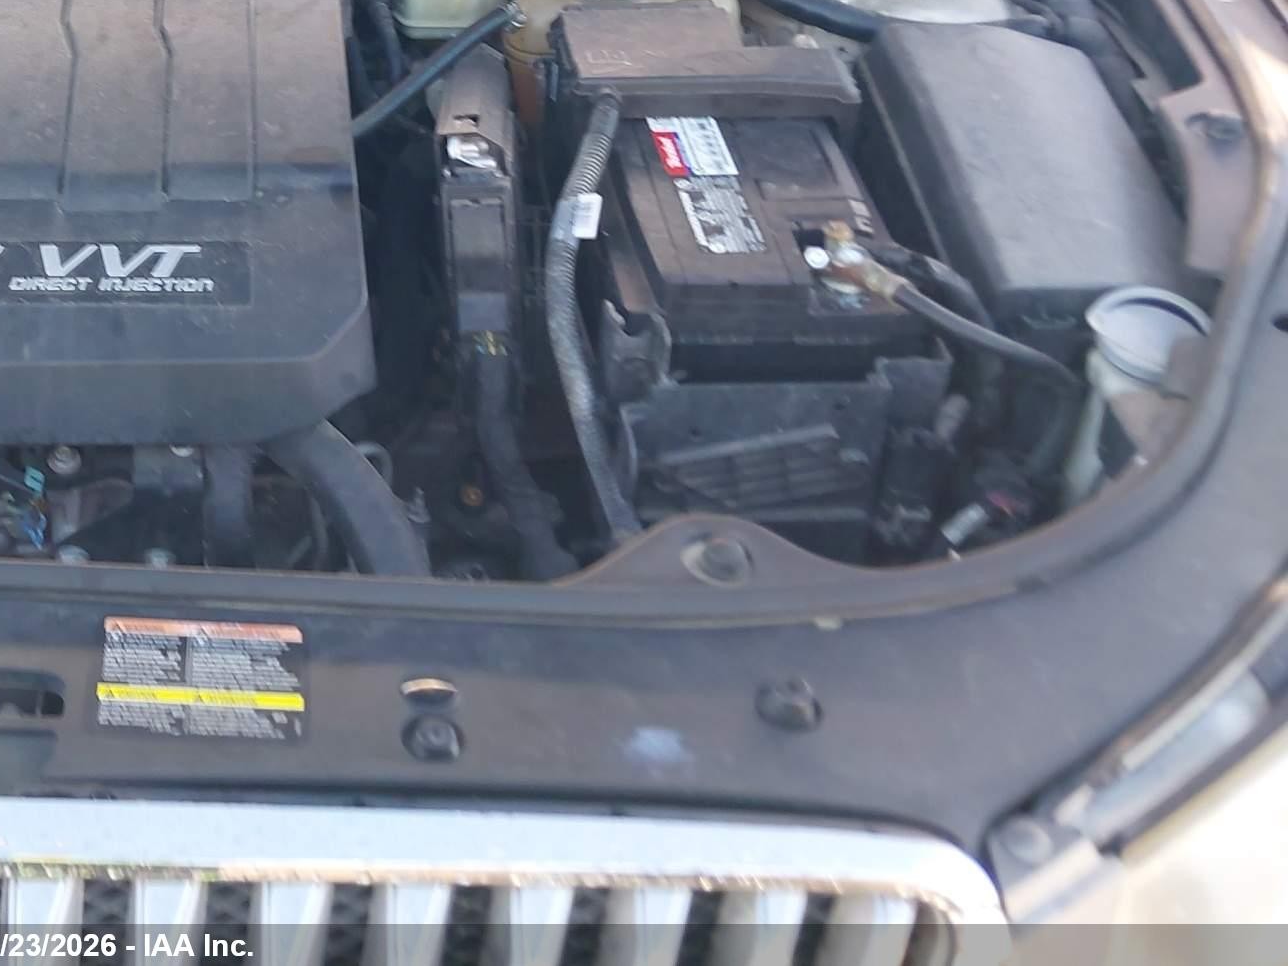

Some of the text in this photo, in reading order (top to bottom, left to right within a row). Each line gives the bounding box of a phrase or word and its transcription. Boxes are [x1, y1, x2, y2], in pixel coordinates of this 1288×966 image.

[38, 243, 202, 278] VVT
[8, 276, 215, 292] DIRECT INJECTION
